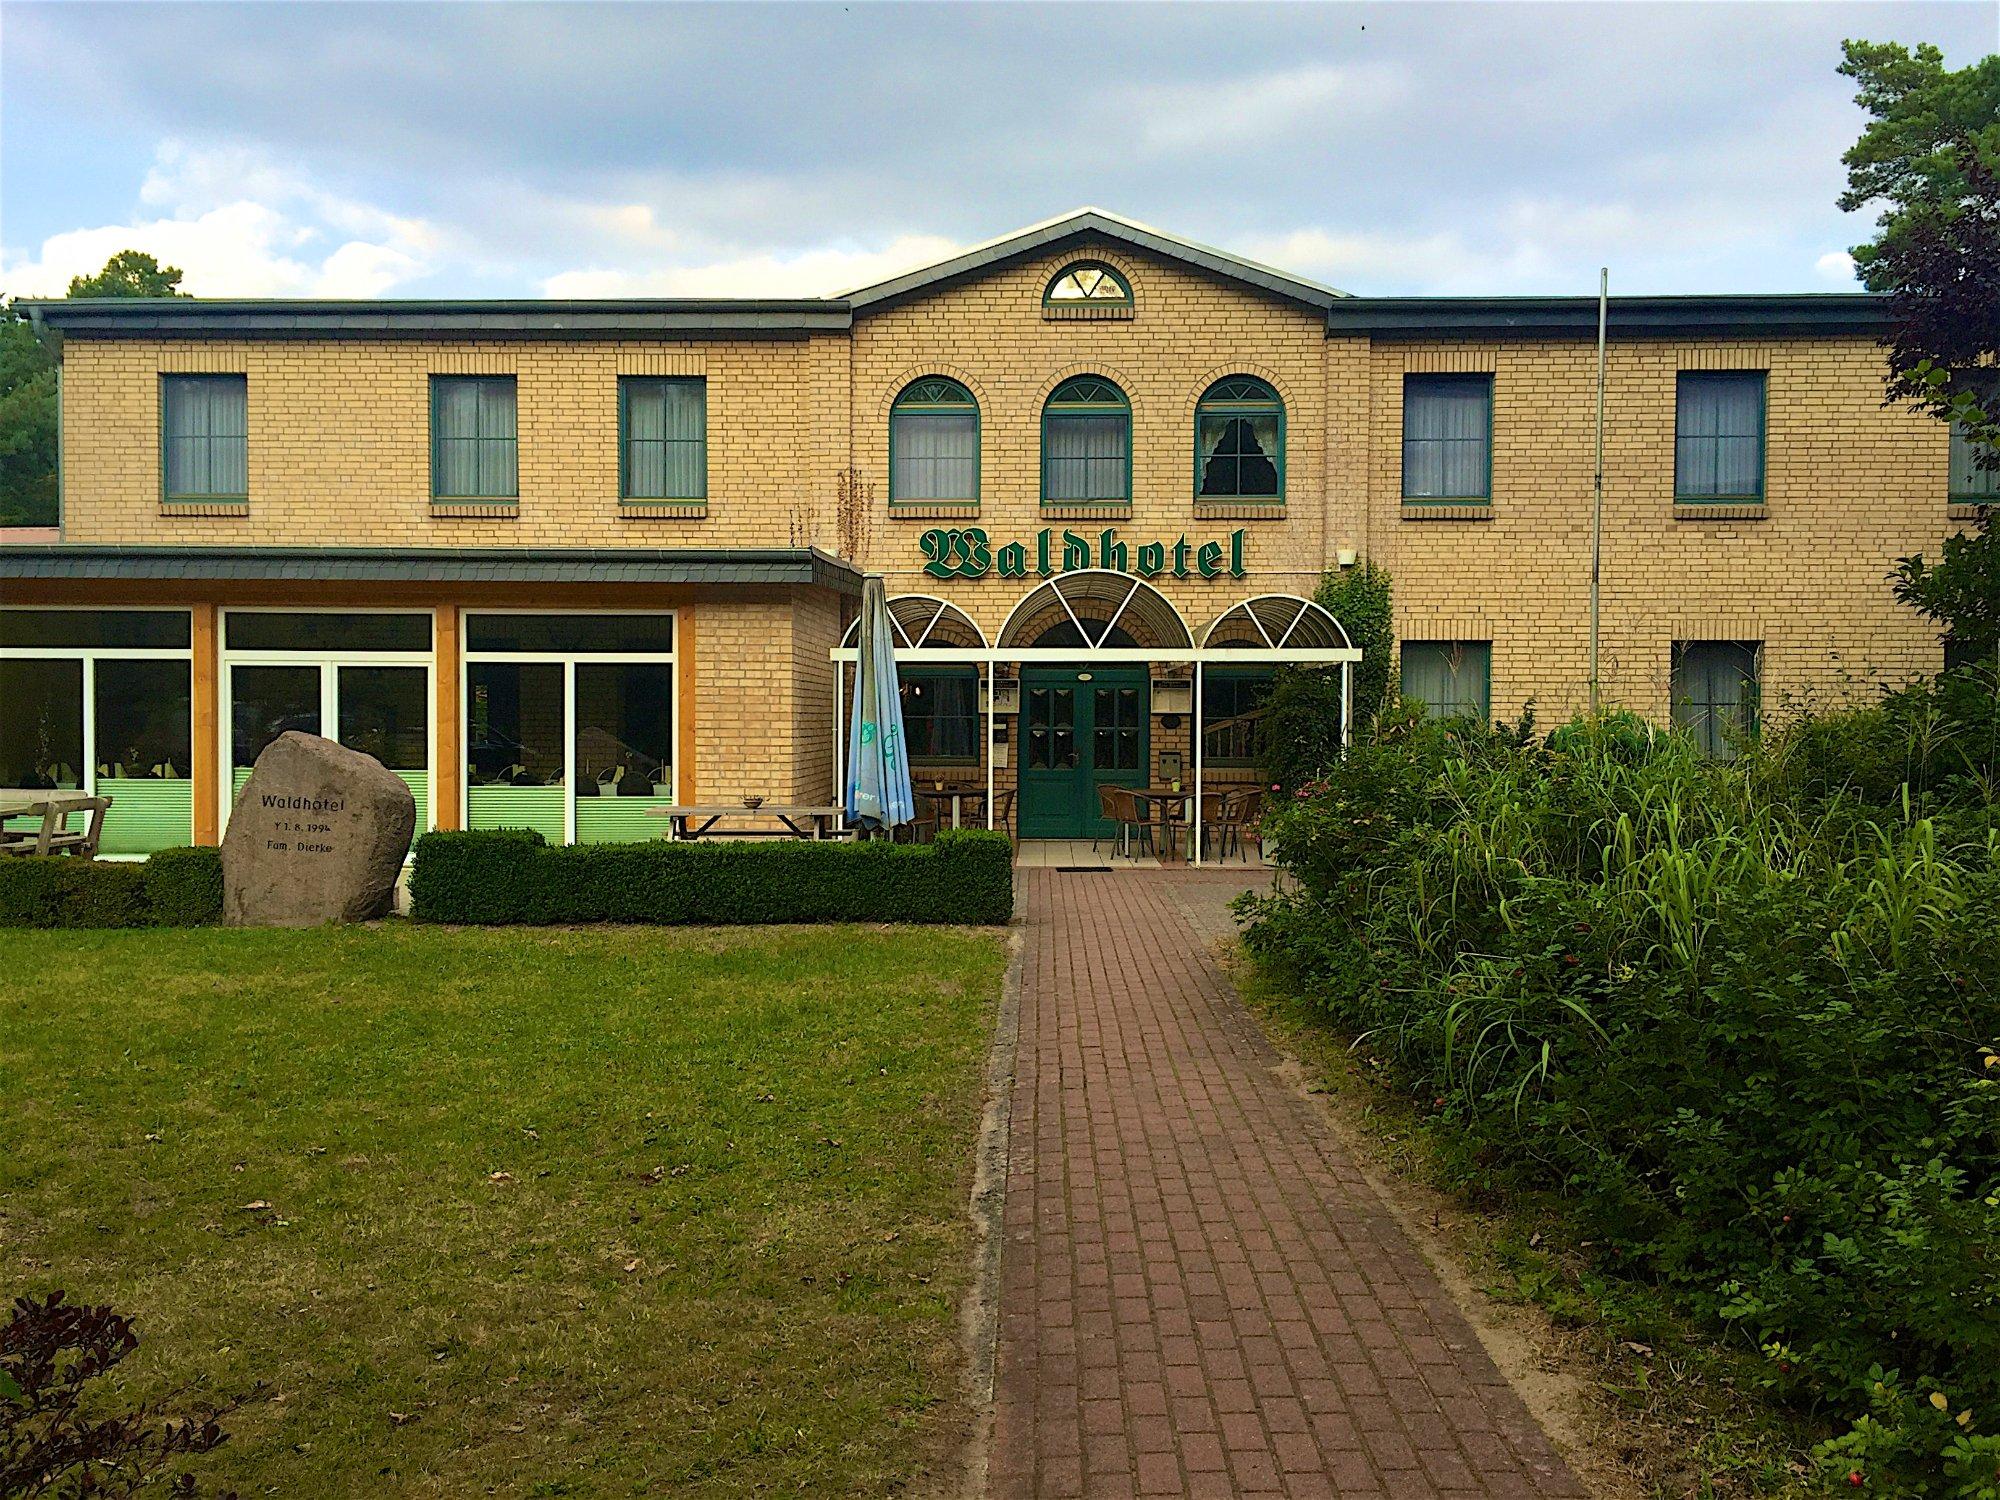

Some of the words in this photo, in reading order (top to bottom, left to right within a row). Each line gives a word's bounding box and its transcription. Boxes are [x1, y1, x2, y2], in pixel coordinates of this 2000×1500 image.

[919, 527, 1247, 579] Waldhotel
[262, 795, 345, 812] Waldhotel
[267, 840, 292, 851] Fam.
[297, 842, 333, 853] Dierke
